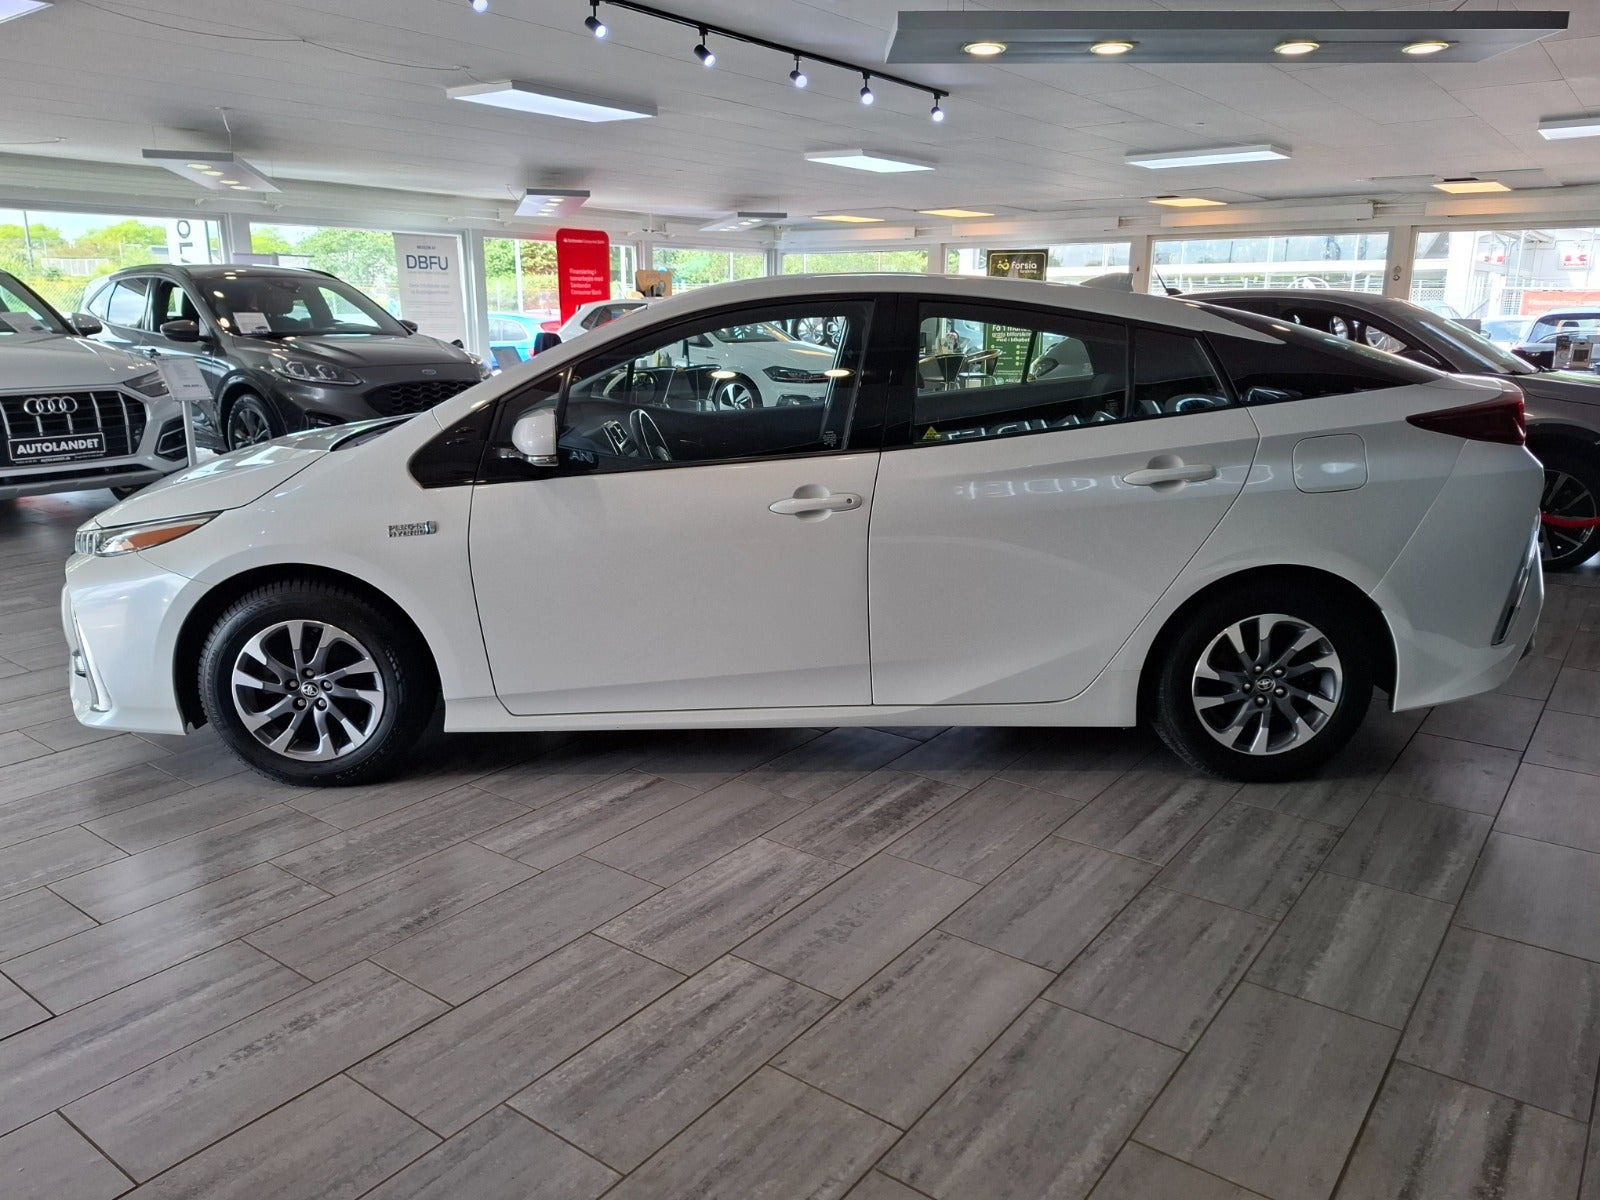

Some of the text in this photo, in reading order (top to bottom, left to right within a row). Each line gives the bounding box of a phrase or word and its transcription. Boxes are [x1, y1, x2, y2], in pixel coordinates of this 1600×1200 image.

[406, 254, 449, 271] DBFU
[1011, 260, 1038, 270] forsia
[16, 439, 99, 454] AUTOLANDET
